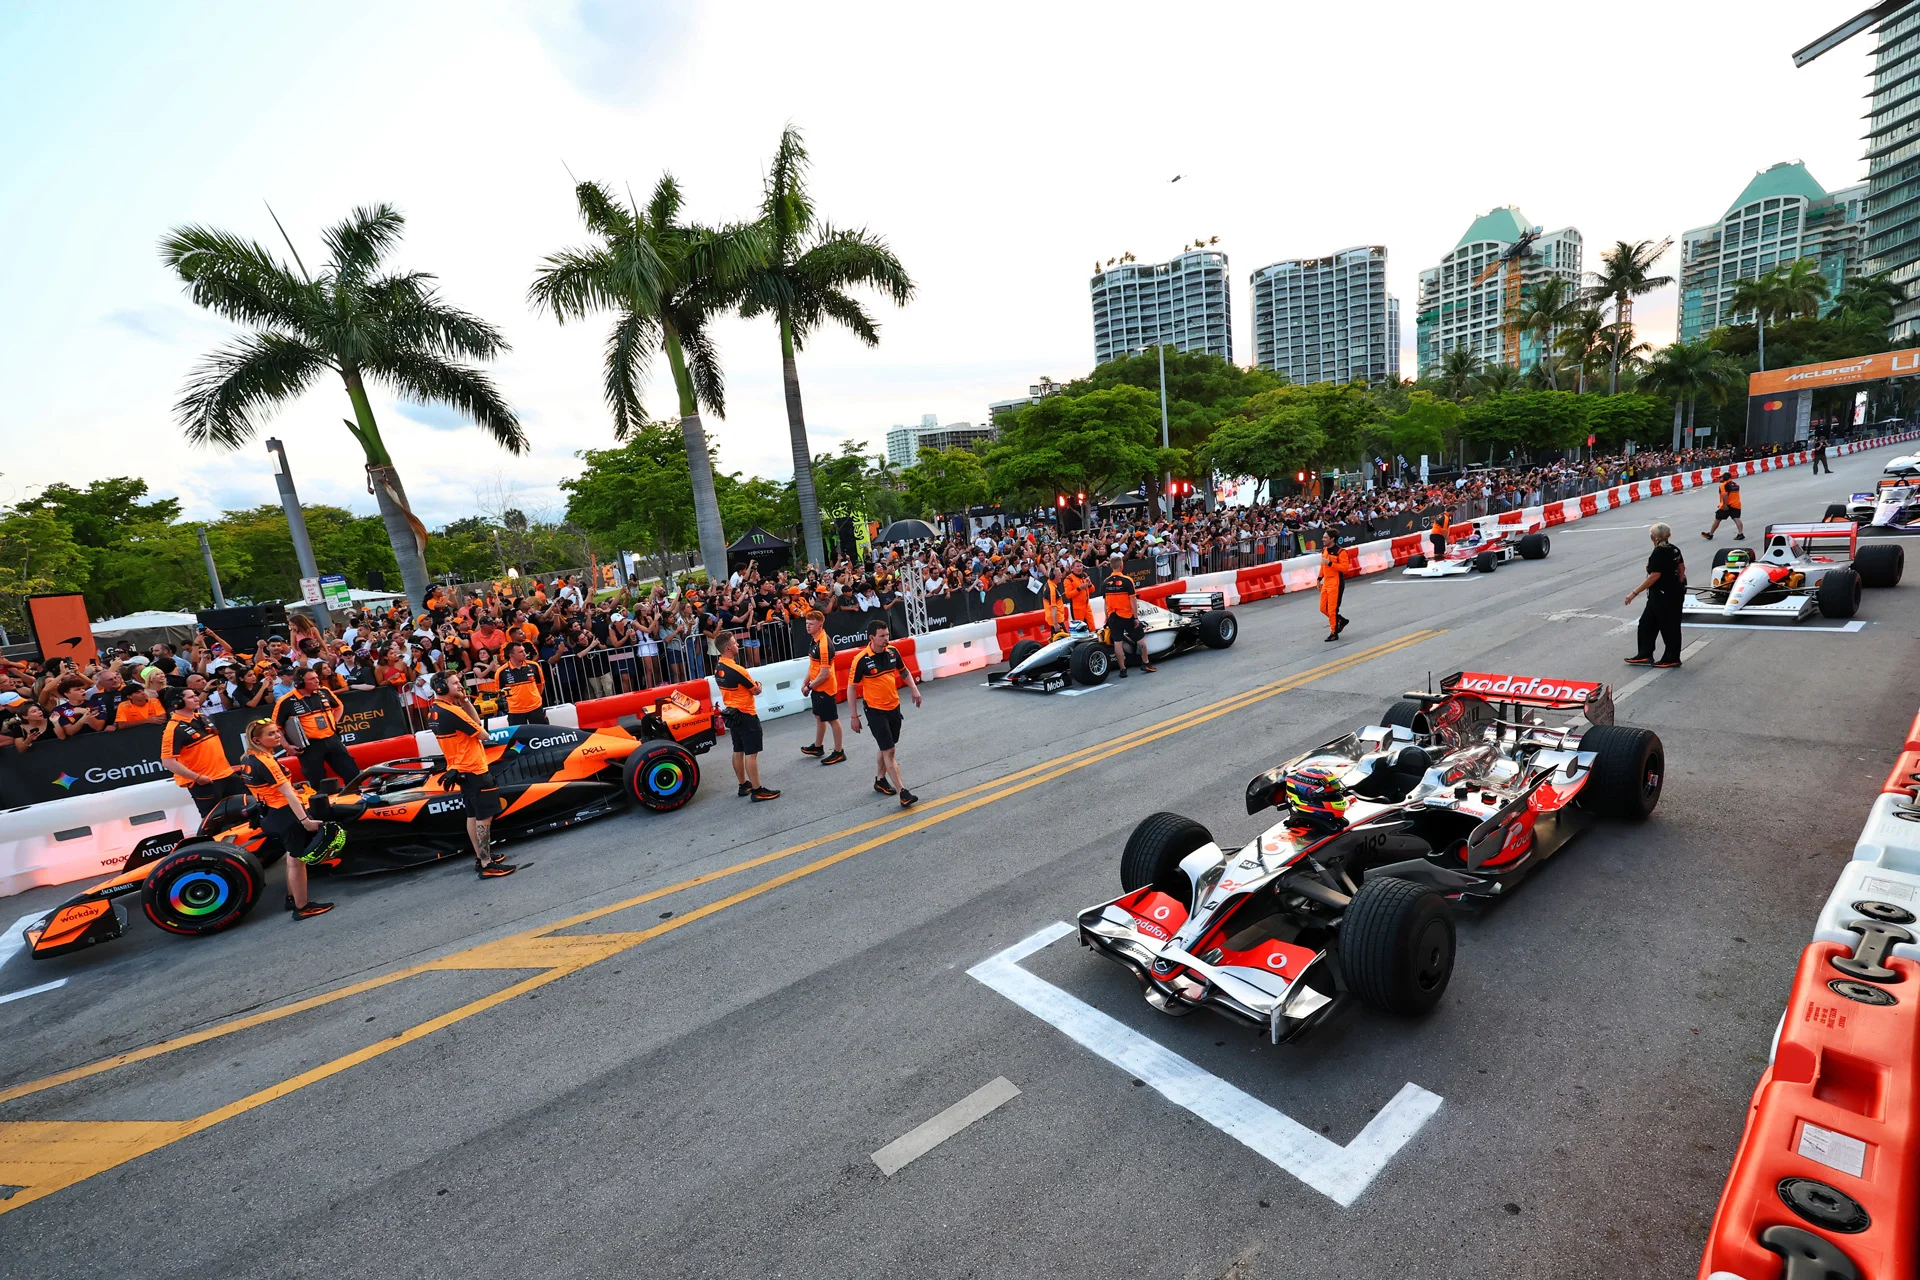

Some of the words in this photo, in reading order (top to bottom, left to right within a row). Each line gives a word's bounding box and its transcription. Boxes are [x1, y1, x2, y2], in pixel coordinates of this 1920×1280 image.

[1784, 361, 1866, 382] McLaren
[928, 616, 947, 627] llwyn
[833, 631, 868, 645] Gemini
[1463, 676, 1590, 700] vodafone
[682, 717, 709, 728] Dropbox
[529, 732, 578, 749] Gemini
[582, 746, 605, 755] DELL
[85, 758, 168, 783] Gemin
[373, 808, 407, 817] VELO
[1355, 833, 1386, 859] aigo
[157, 854, 199, 876] ZERO
[1241, 860, 1257, 869] SAP
[60, 907, 99, 923] workday
